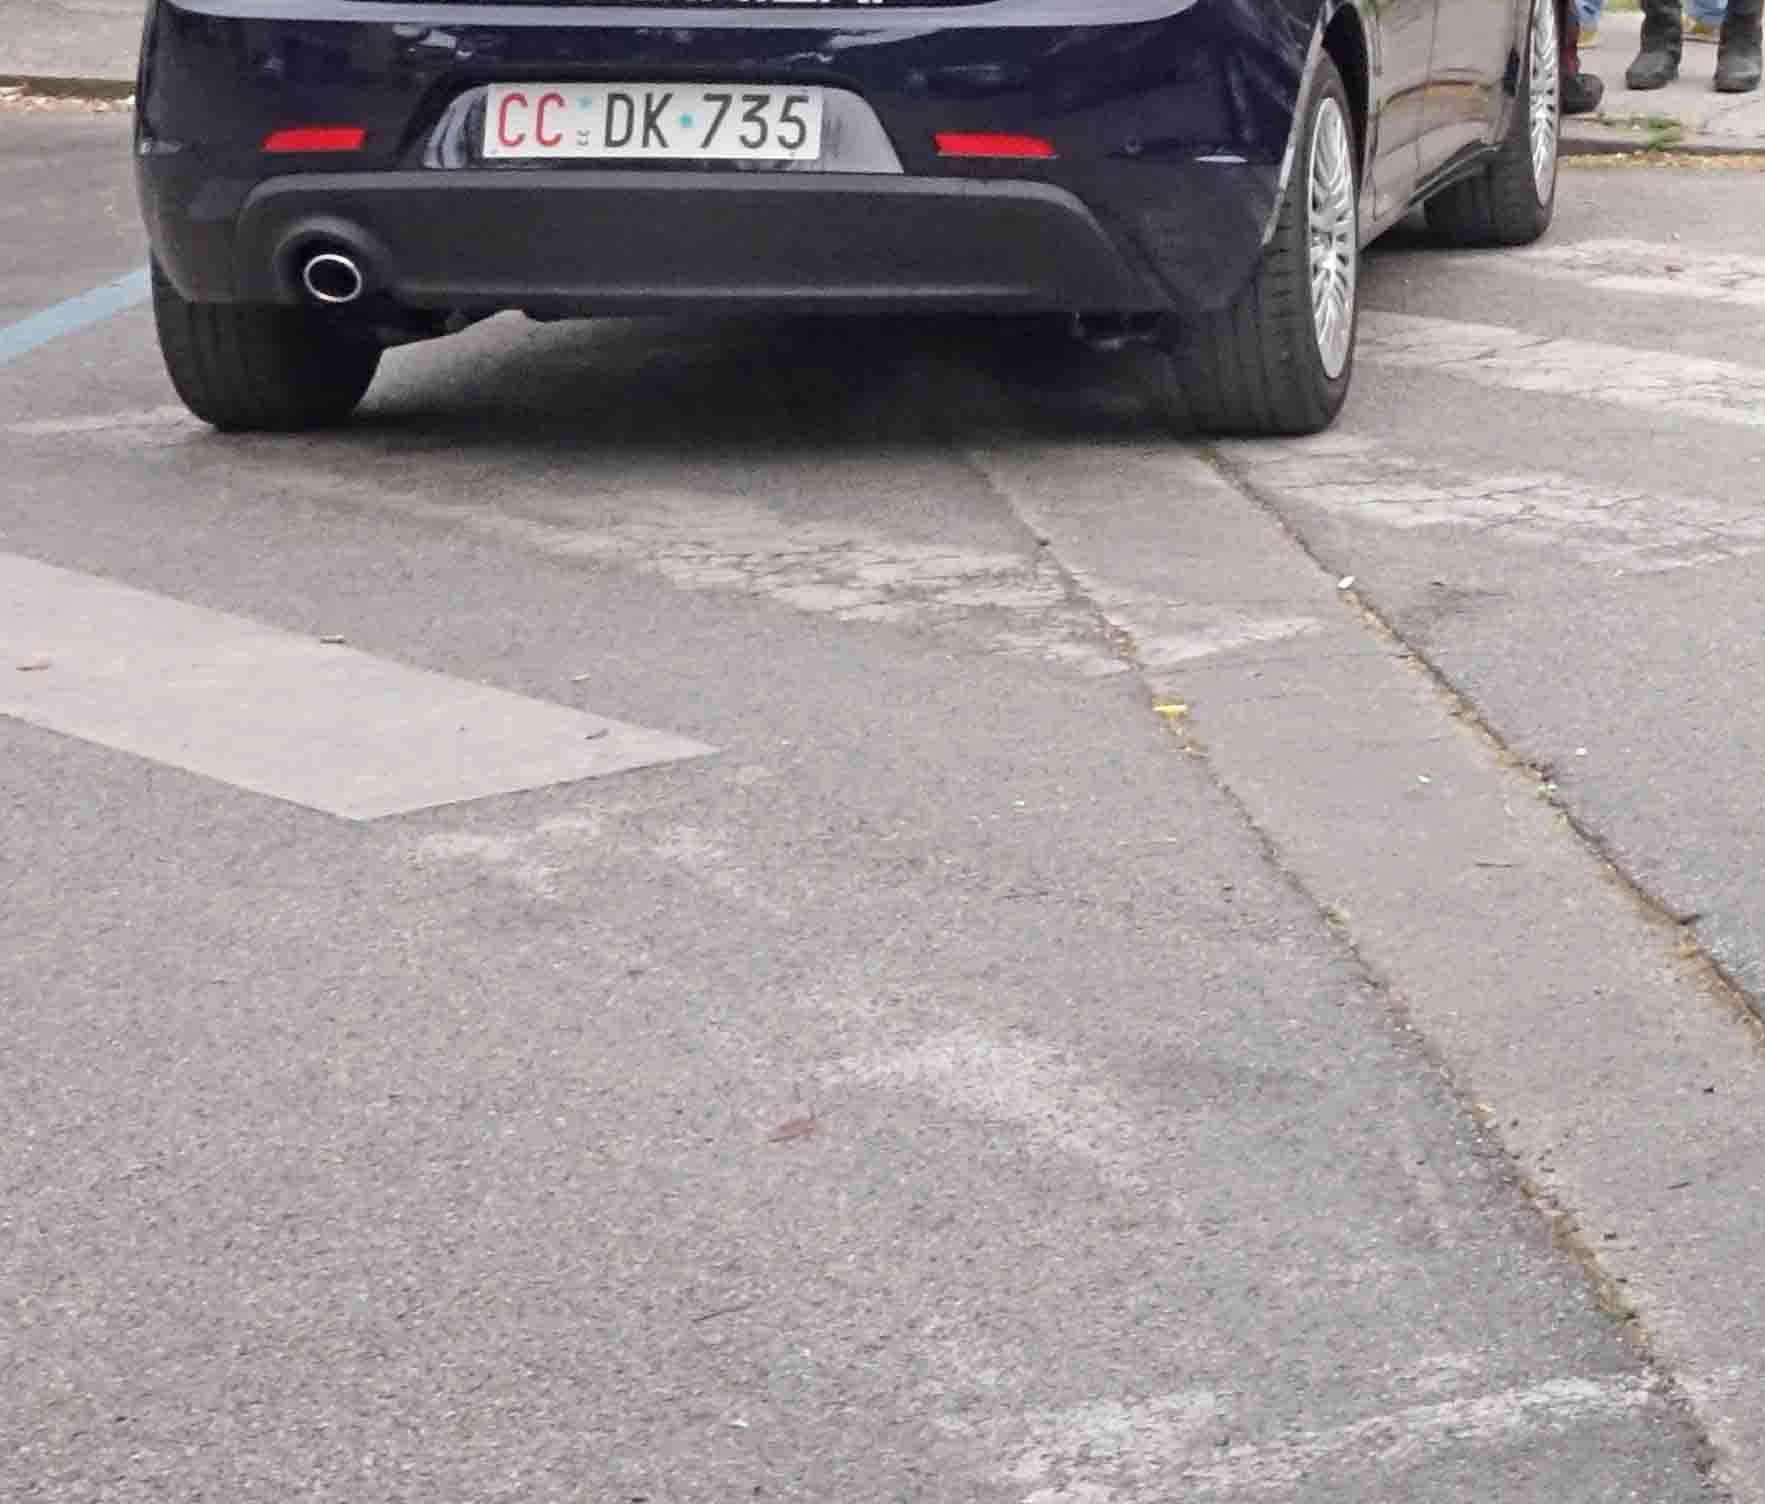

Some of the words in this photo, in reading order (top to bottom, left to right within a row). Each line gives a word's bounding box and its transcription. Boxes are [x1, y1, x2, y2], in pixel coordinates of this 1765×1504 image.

[497, 92, 564, 147] CC
[603, 92, 669, 149] DK
[699, 93, 808, 150] 735
